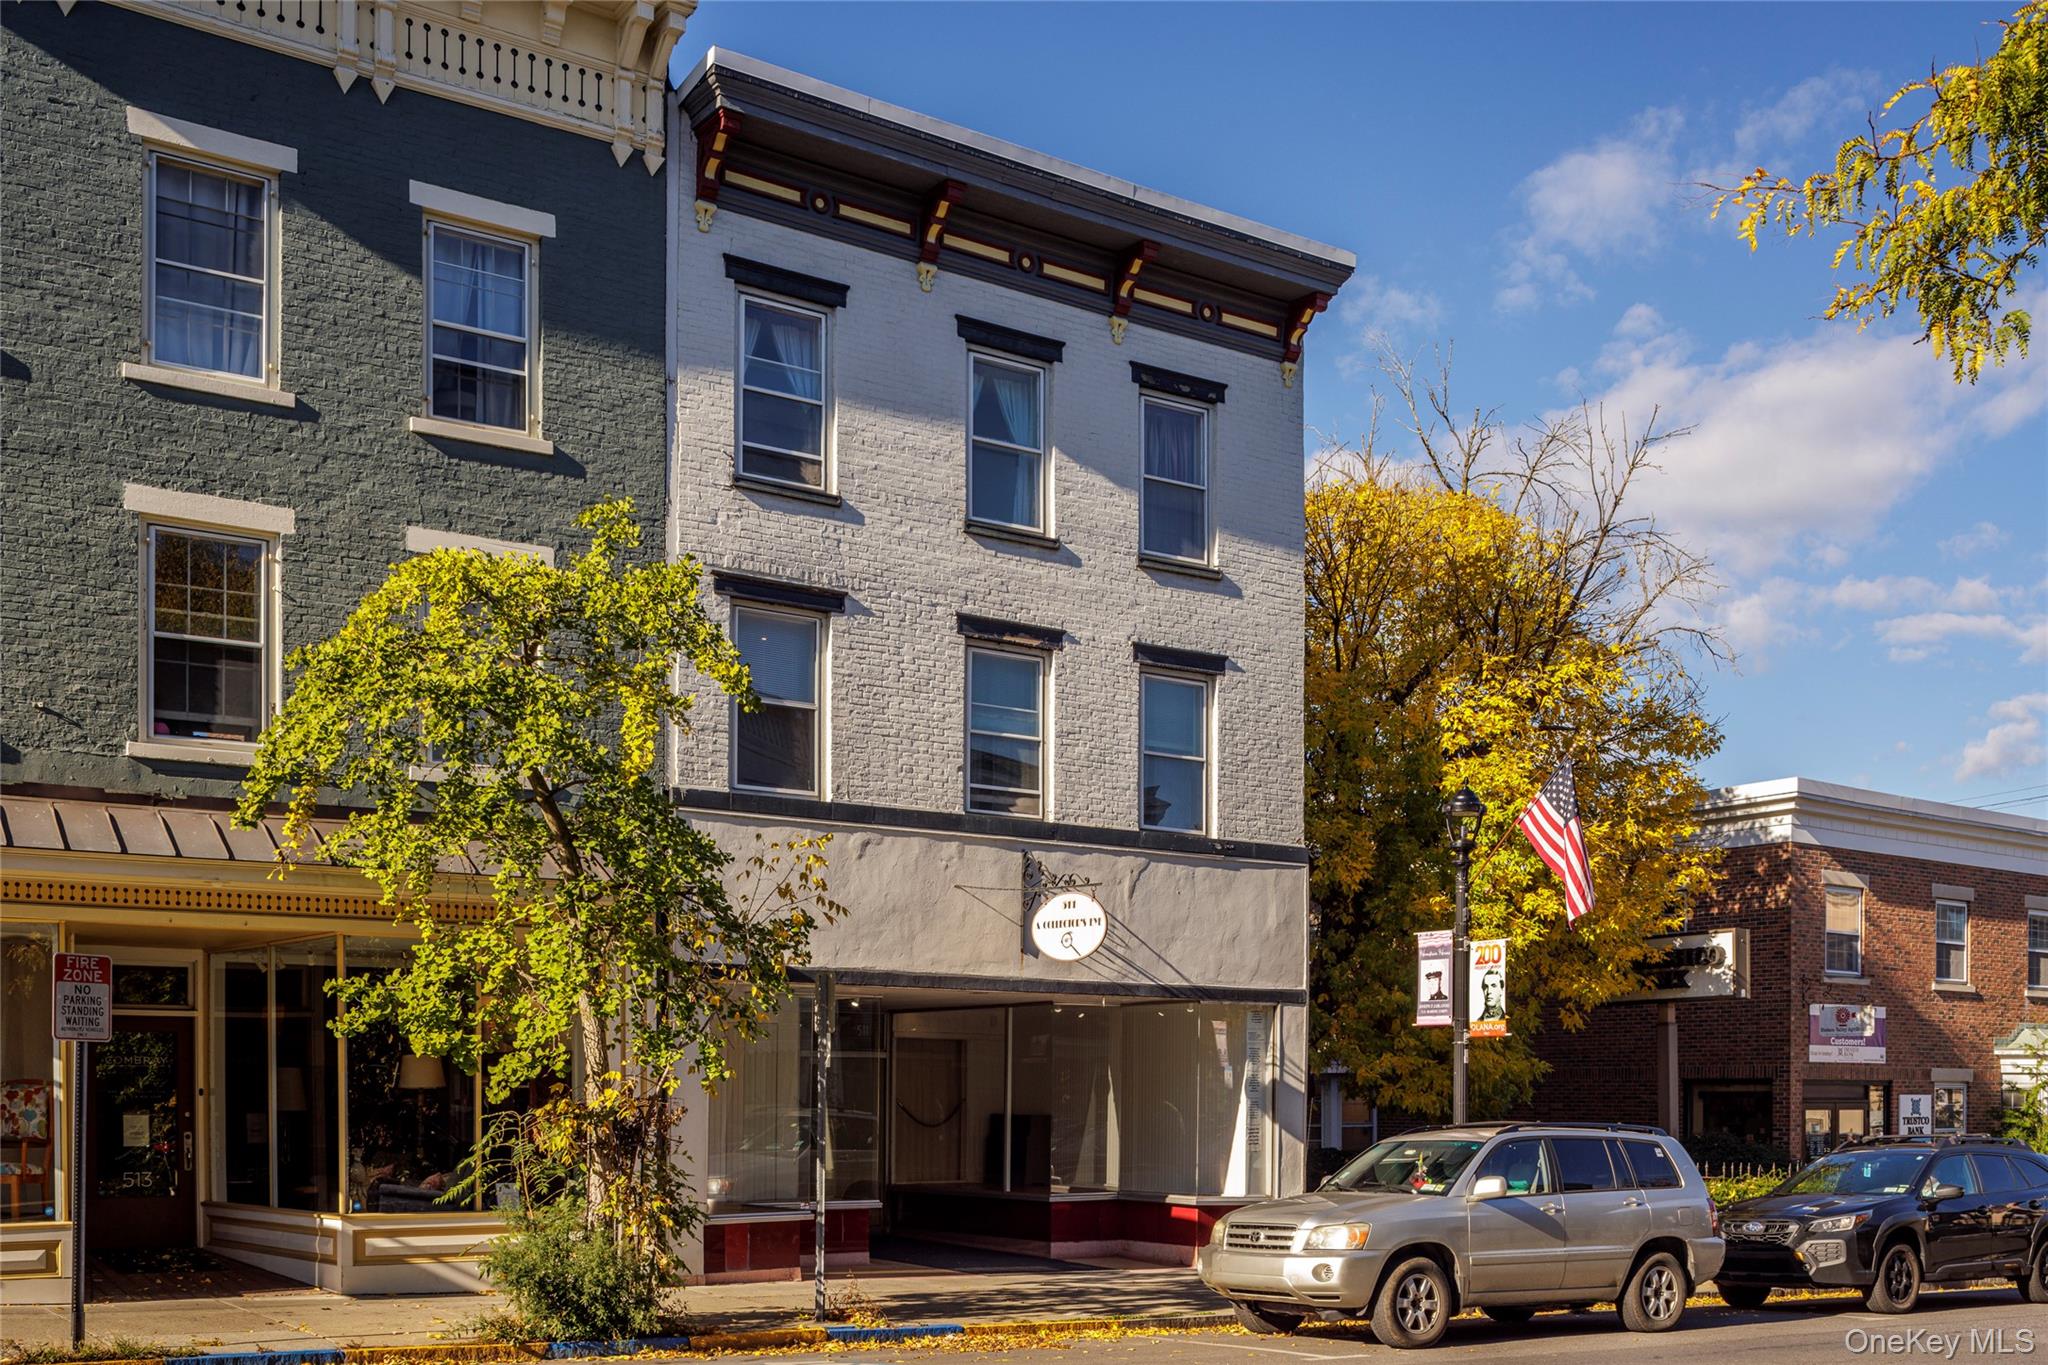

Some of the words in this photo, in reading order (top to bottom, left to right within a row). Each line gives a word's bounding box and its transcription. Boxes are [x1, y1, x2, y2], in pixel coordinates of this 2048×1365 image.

[1475, 944, 1501, 965] 200
[66, 956, 99, 969] FIRE
[63, 968, 103, 982] ZONE
[74, 985, 91, 995] NO
[63, 995, 102, 1006] PARKING
[61, 1006, 104, 1017] STANDING
[65, 1016, 100, 1027] WAITING
[1830, 1037, 1866, 1046] Customers!
[1902, 1117, 1930, 1125] TRUSTCO
[1907, 1126, 1925, 1135] BANK
[123, 1172, 153, 1187] 513
